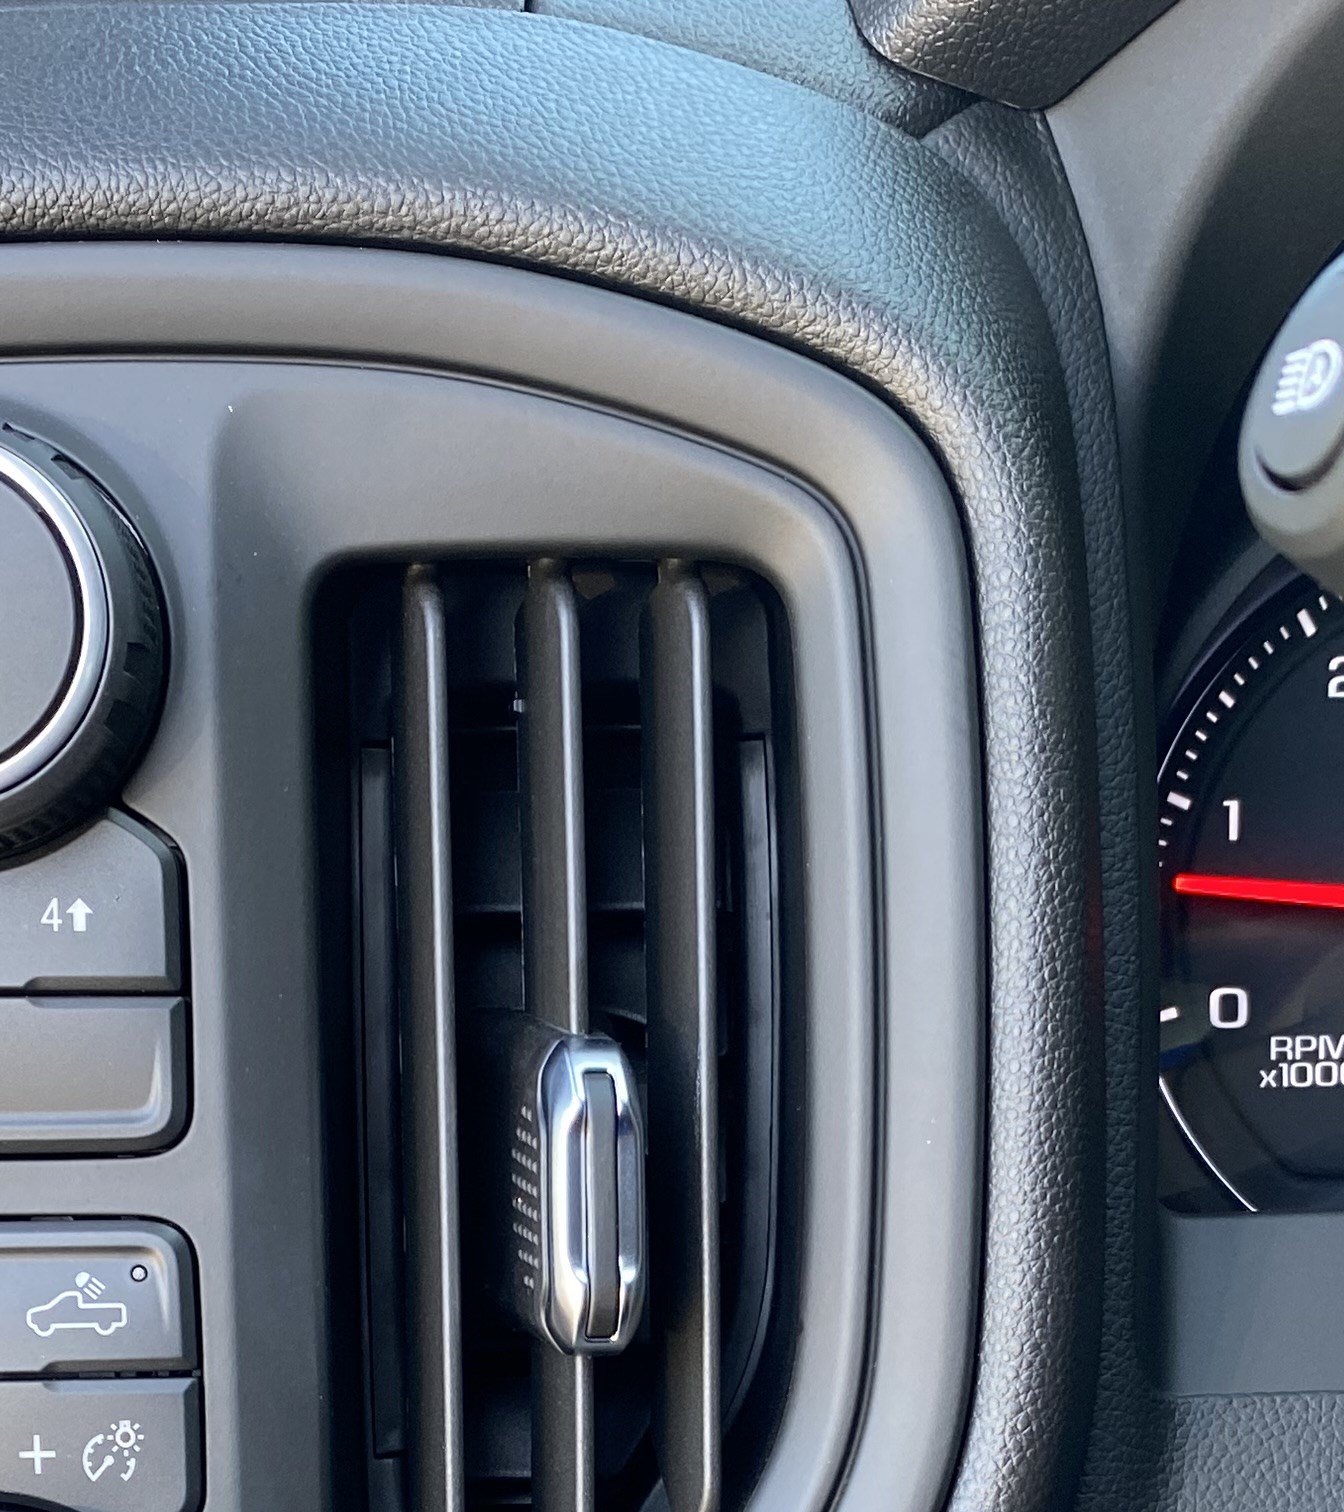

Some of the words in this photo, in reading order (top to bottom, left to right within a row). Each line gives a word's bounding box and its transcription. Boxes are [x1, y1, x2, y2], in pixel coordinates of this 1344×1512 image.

[1222, 799, 1240, 841] 1
[40, 897, 63, 932] 4
[1209, 987, 1249, 1029] 0
